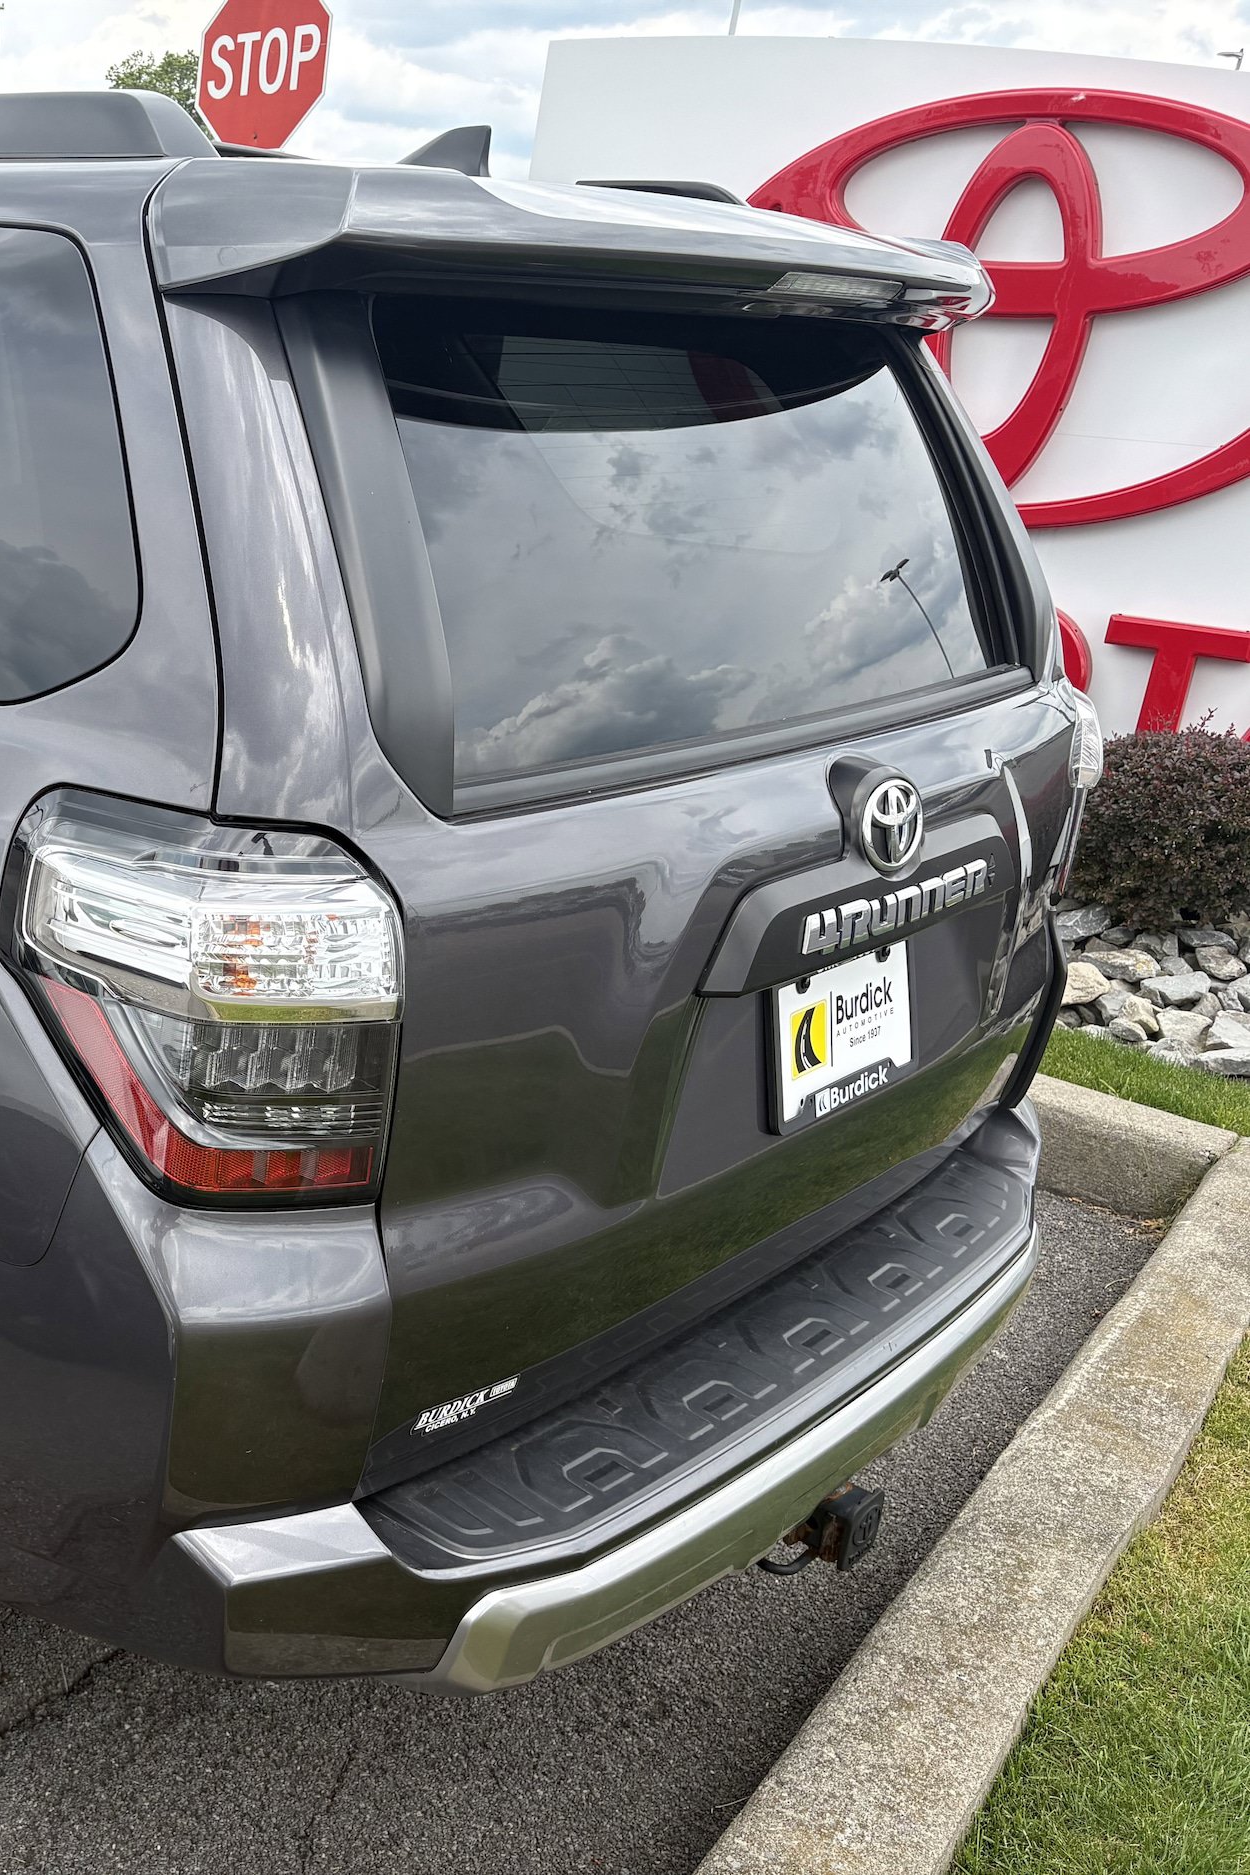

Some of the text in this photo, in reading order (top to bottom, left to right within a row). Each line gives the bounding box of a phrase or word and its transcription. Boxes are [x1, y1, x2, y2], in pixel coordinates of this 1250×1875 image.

[207, 24, 321, 99] STOP
[801, 858, 988, 955] 4RUNNER
[836, 976, 893, 1024] Burdick
[836, 1007, 895, 1037] AUTOMOTIVE
[849, 1026, 881, 1047] Since 1937
[829, 1065, 889, 1108] Burdick
[416, 1389, 490, 1428] BURDICK
[425, 1416, 458, 1432] CICERO,
